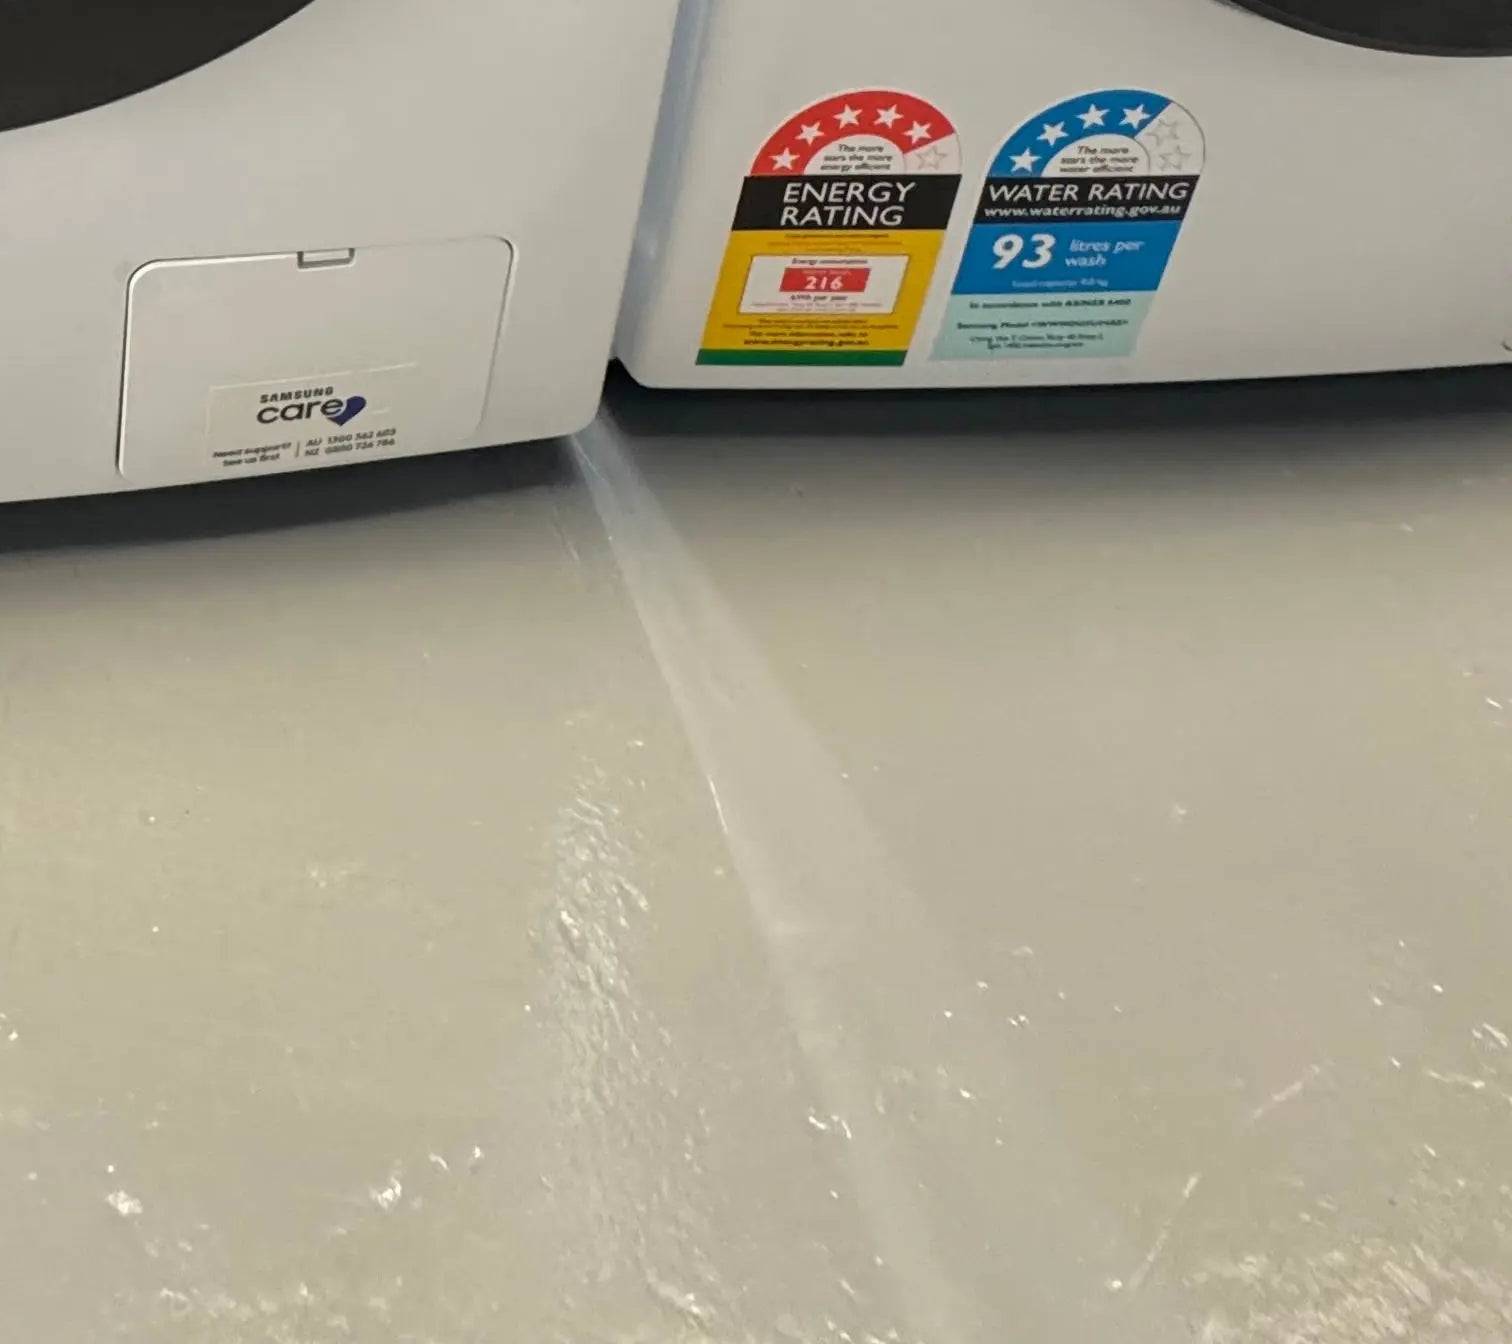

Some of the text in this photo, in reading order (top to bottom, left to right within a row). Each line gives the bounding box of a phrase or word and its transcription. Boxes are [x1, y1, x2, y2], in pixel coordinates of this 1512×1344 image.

[839, 144, 883, 153] The more
[1077, 146, 1129, 155] The more
[866, 154, 892, 162] more
[1089, 156, 1104, 164] the
[1108, 156, 1138, 164] more
[821, 162, 890, 172] energy efficient
[783, 181, 916, 203] ENERGY
[989, 182, 1189, 202] WATER RATING
[780, 205, 904, 227] RATING
[984, 204, 1181, 219] www.waterrating.gov.au
[992, 233, 1056, 270] 93
[1070, 239, 1145, 254] litres per
[1065, 254, 1106, 267] wash
[805, 276, 843, 290] 216
[260, 386, 334, 404] SAMSUNG
[257, 398, 344, 424] care
